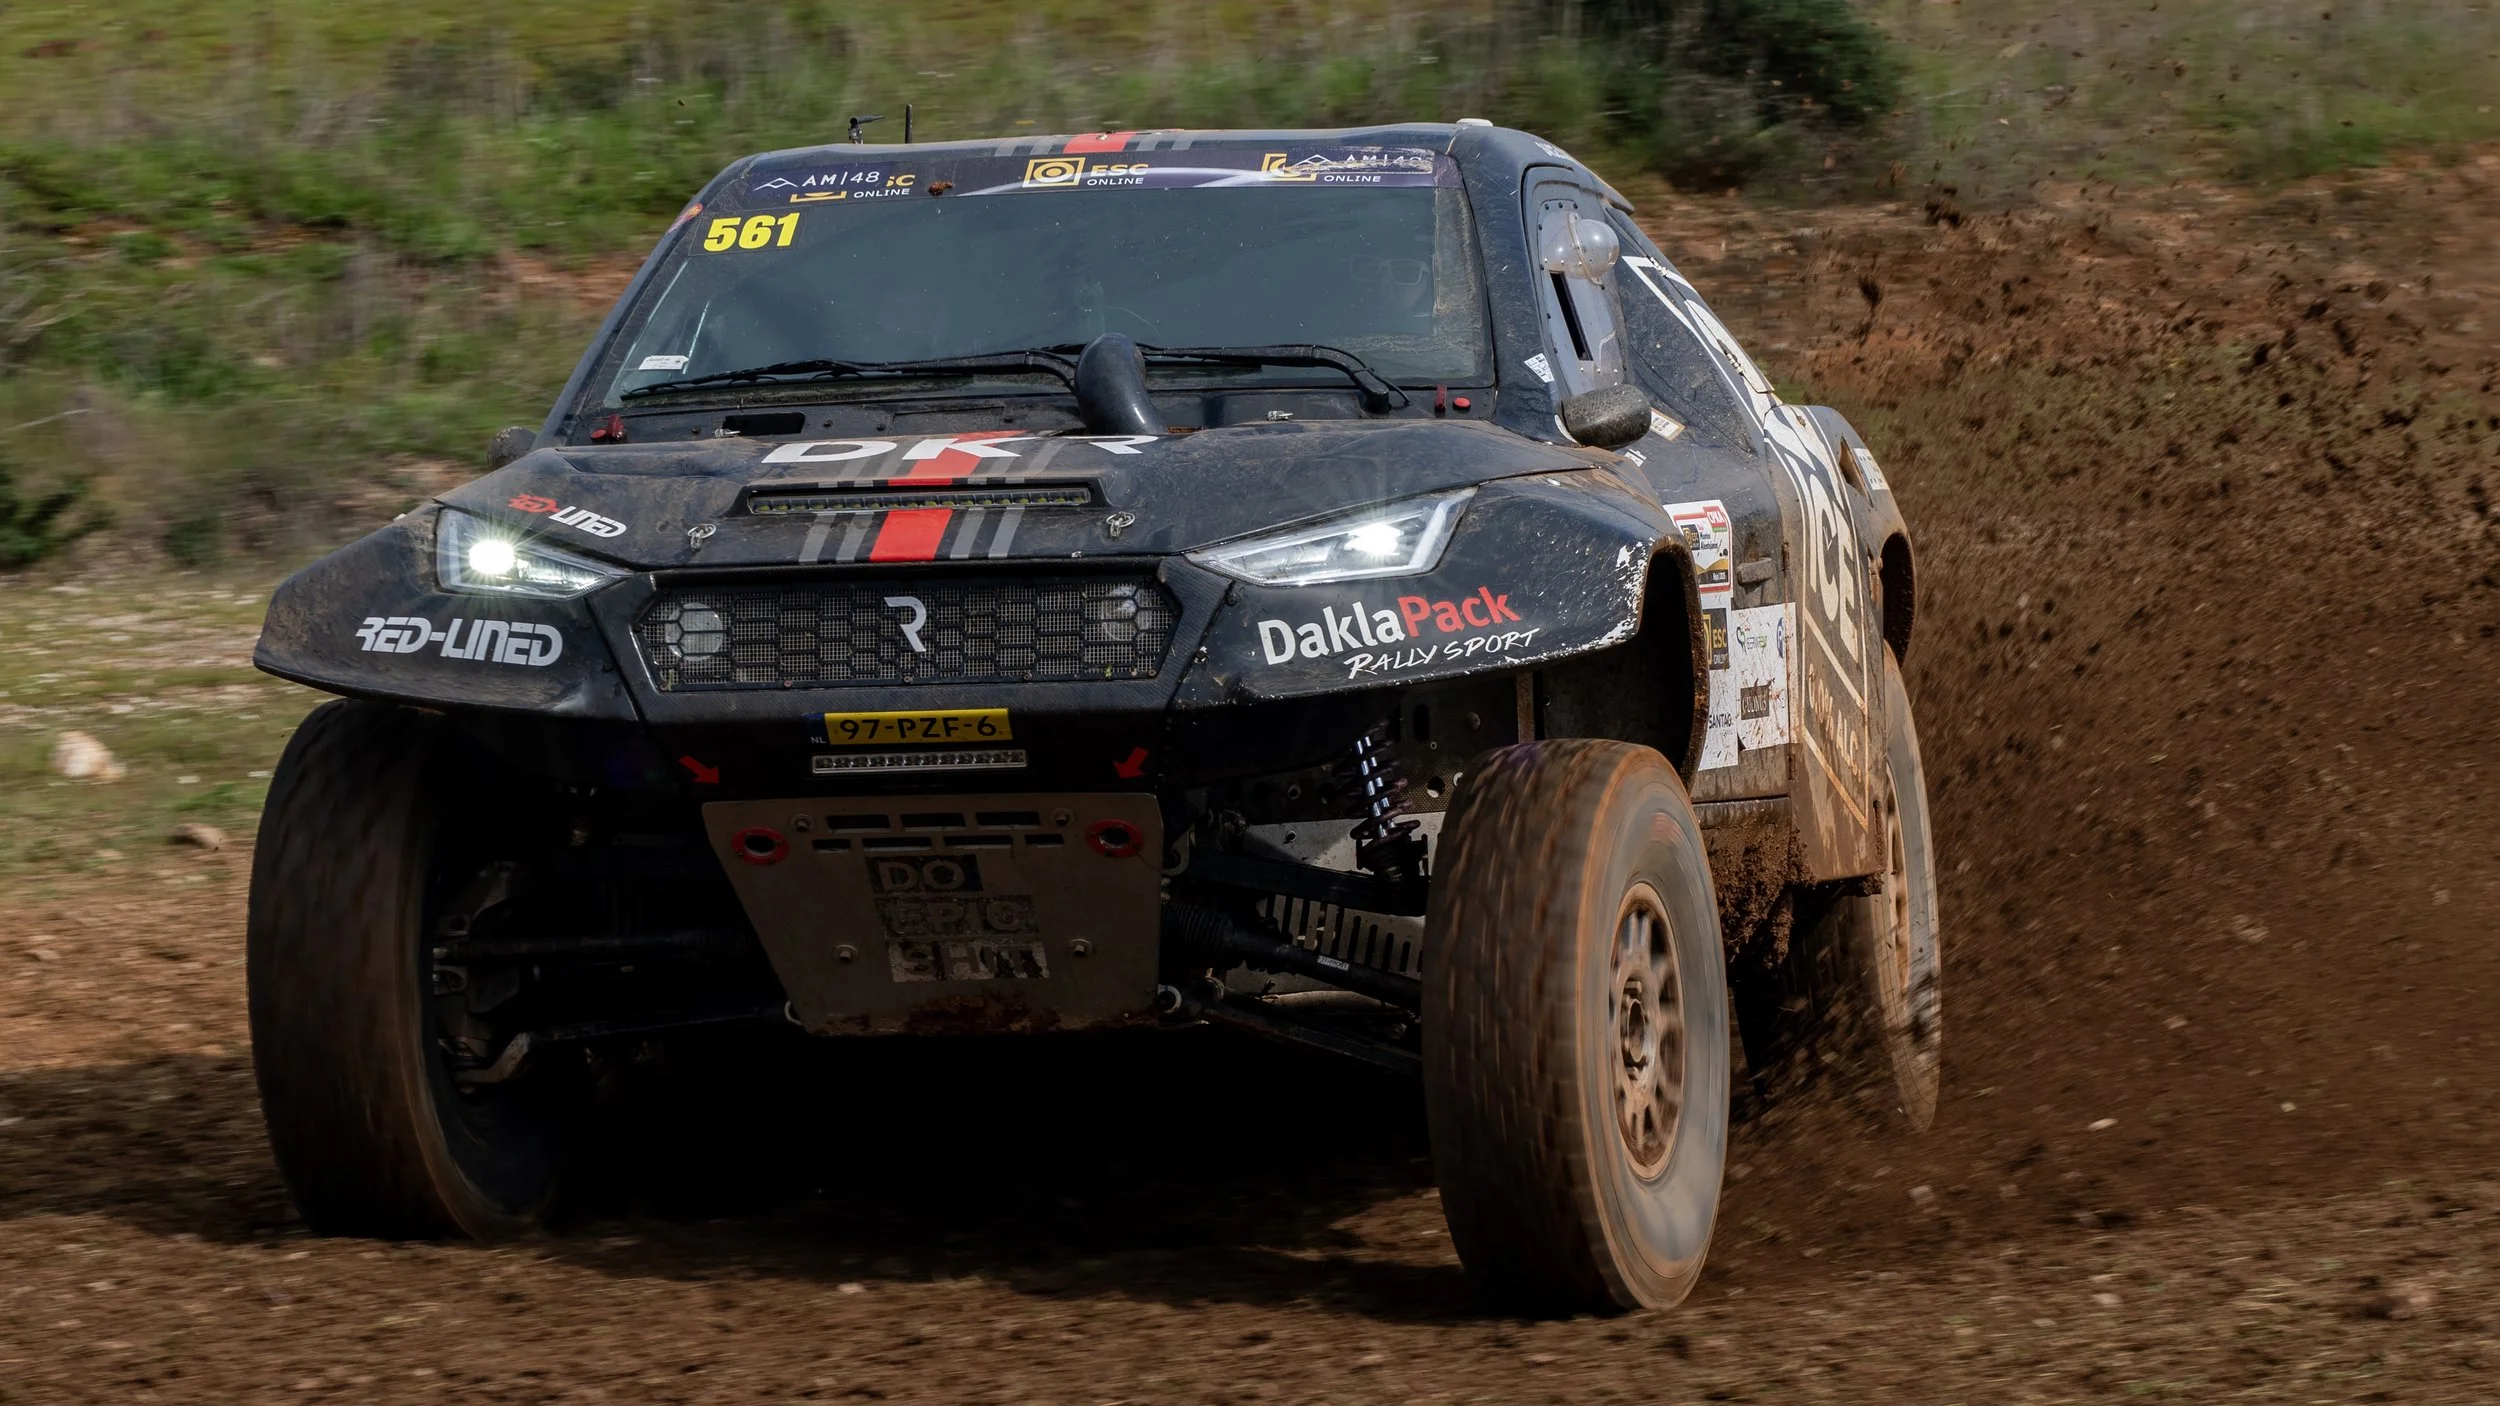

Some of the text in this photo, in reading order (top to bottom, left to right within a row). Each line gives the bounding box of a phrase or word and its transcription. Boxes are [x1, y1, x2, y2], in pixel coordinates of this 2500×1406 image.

[1086, 177, 1145, 186] ONLINE
[1090, 163, 1149, 177] ESC
[1323, 175, 1382, 183] ONLINE
[853, 188, 911, 199] ONLINE
[703, 212, 801, 252] 561
[761, 434, 1159, 464] DKR
[507, 493, 627, 538] RED-LINED
[884, 596, 927, 652] R
[1257, 585, 1522, 666] DaklaPack
[355, 616, 563, 667] RED-LINED
[1343, 628, 1540, 680] RALLY SPORT
[811, 736, 827, 745] NL
[839, 715, 997, 740] 97-PZF-6
[877, 860, 966, 891] DO
[889, 899, 1024, 935] EPIC
